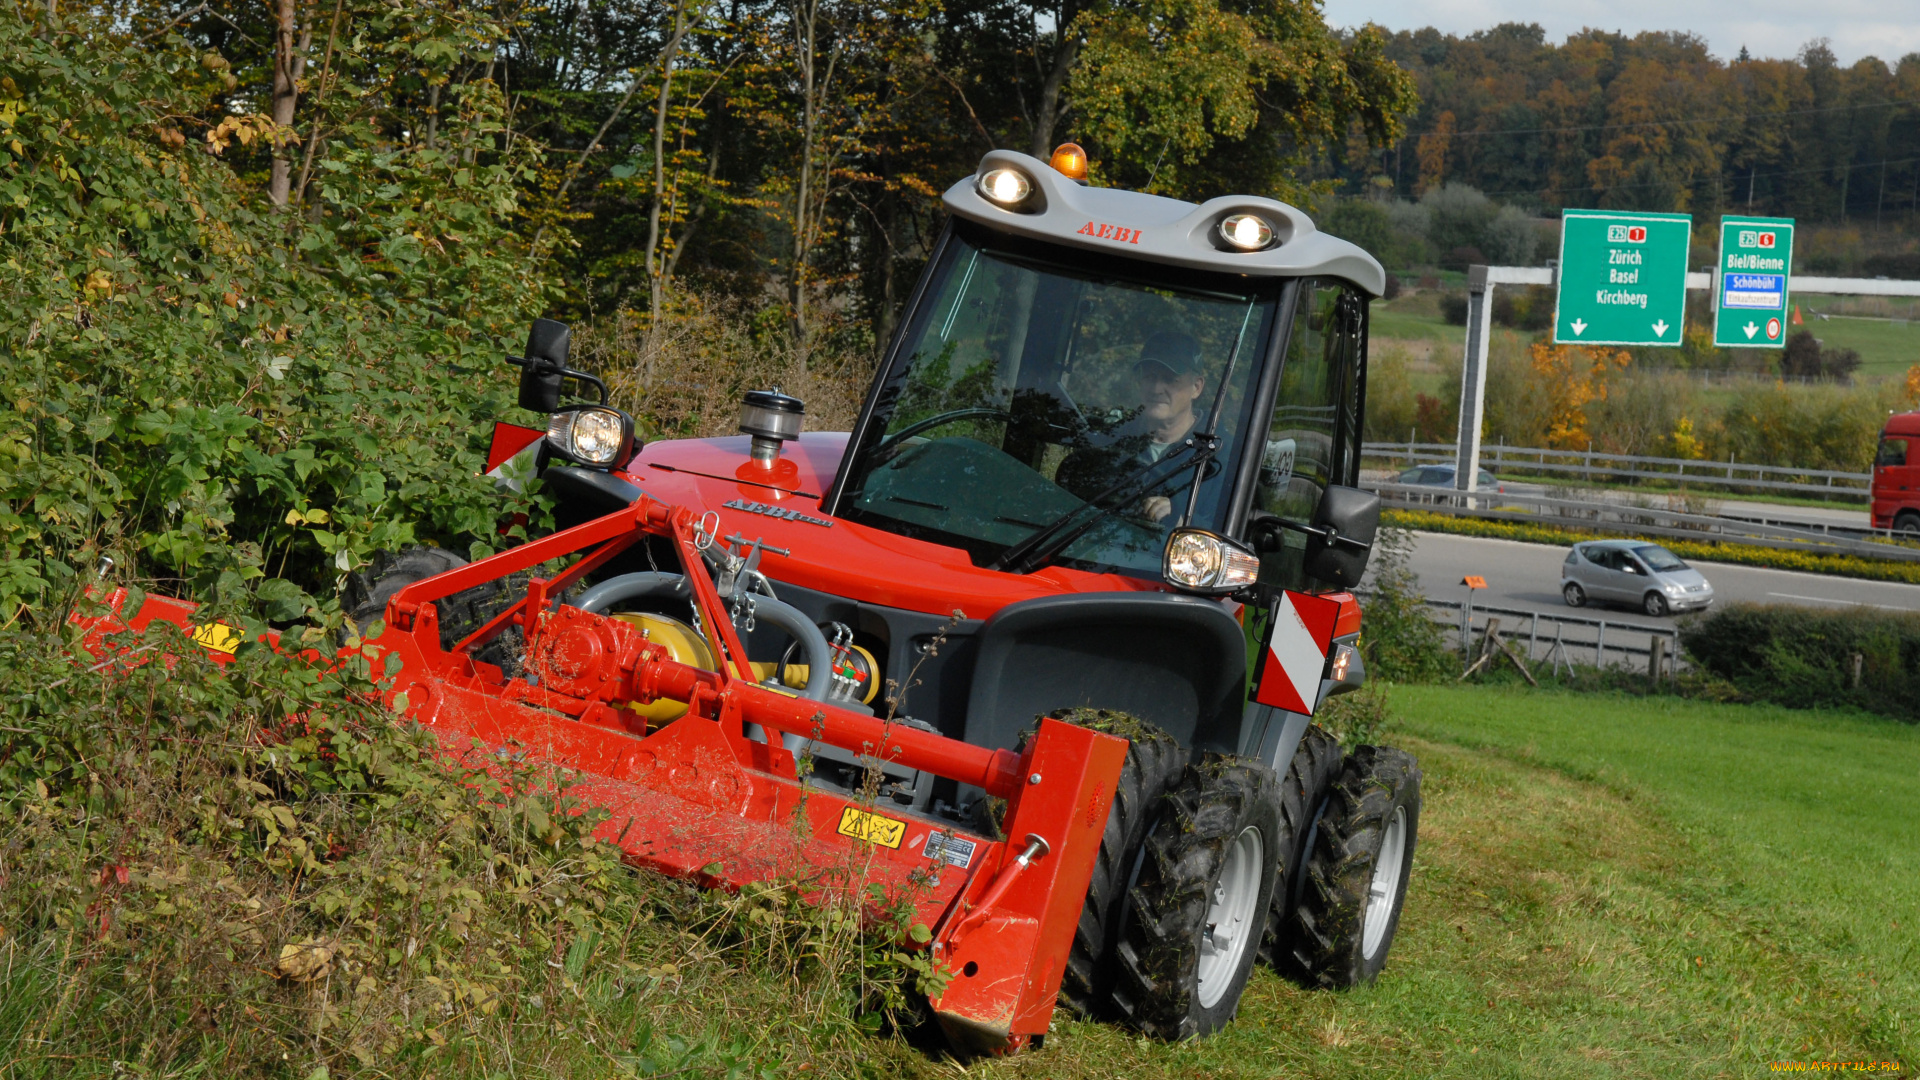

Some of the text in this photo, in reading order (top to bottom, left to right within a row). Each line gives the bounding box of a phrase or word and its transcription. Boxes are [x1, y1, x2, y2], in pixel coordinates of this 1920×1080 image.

[1077, 221, 1143, 244] AEBI
[1609, 228, 1625, 240] E25
[1608, 249, 1642, 265] Zürich
[1727, 253, 1784, 270] Biel/Bienne
[1609, 268, 1639, 284] Basel
[1733, 275, 1775, 289] Schönbühl
[1596, 289, 1648, 309] Kirchberg
[722, 499, 801, 522] AEBI
